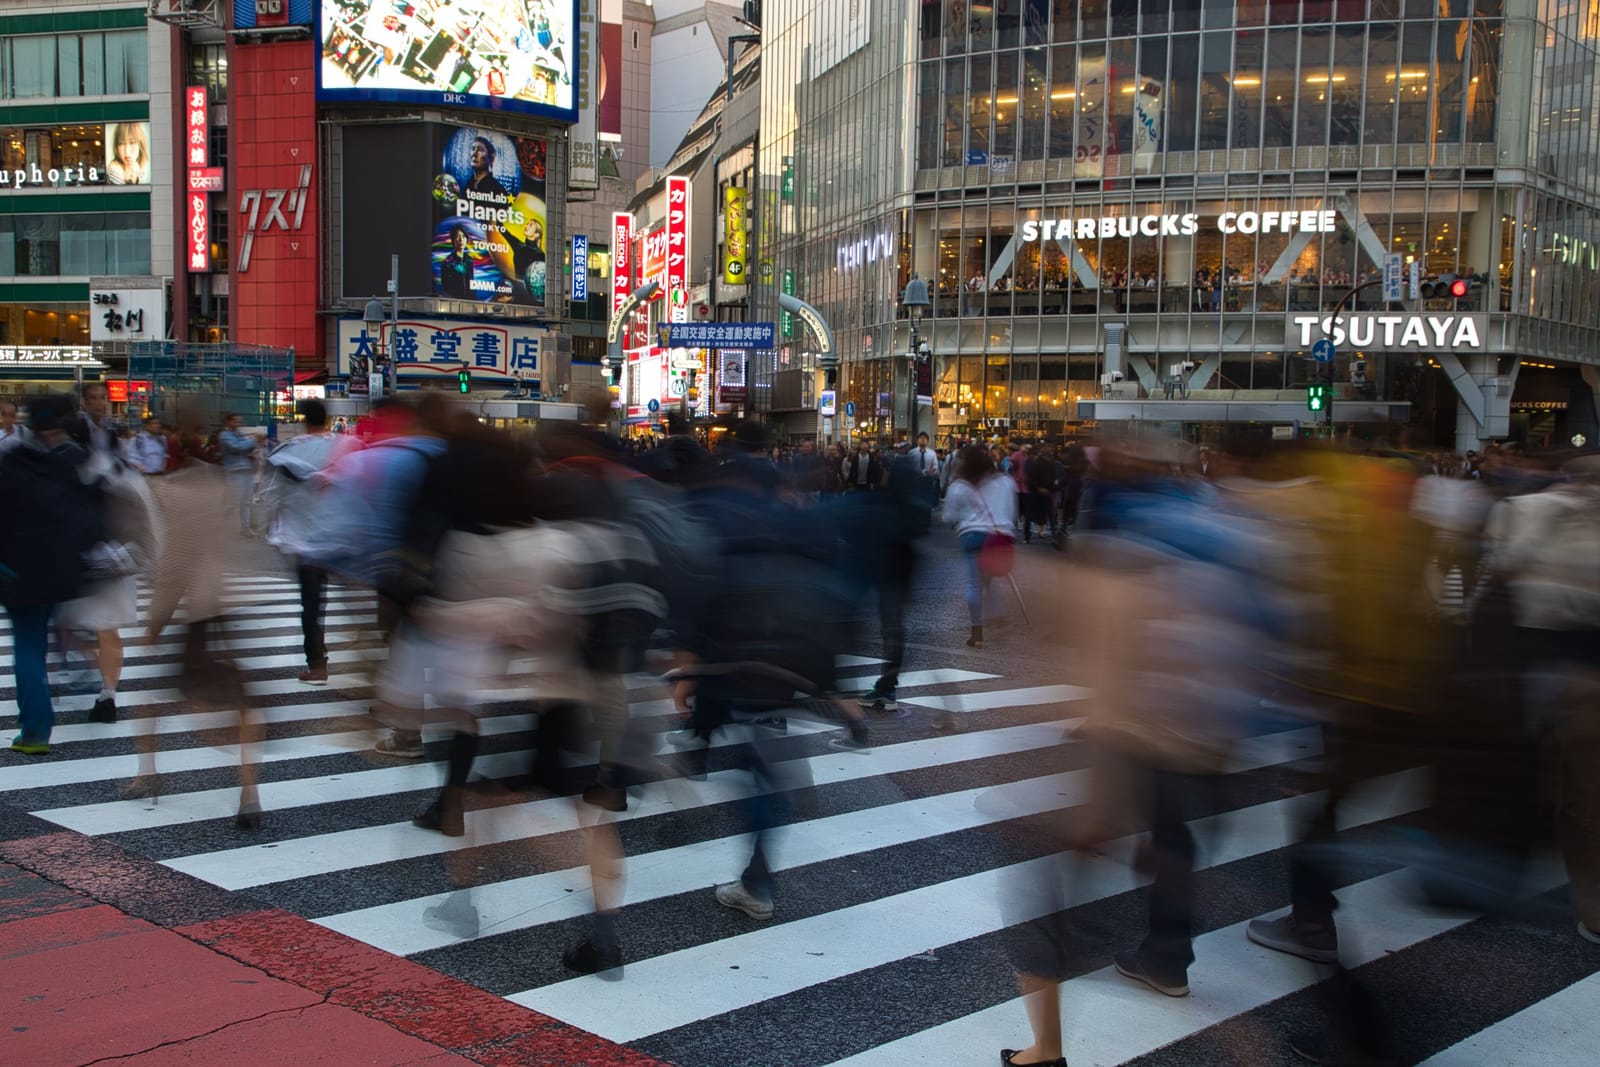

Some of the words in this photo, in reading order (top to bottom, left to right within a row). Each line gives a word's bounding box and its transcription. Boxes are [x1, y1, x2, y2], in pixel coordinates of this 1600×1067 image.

[442, 92, 466, 104] DHC
[465, 188, 507, 204] teamLab
[236, 165, 312, 272] クスリ
[456, 198, 525, 225] Planets
[476, 223, 506, 233] TOKYO
[669, 189, 685, 267] カラオケ
[1022, 213, 1199, 242] STARBUCKS
[1217, 210, 1336, 234] COFFEE
[473, 240, 510, 253] TOYOSU
[575, 236, 585, 299] 大盛堂商事ビル
[728, 263, 742, 273] 4F
[469, 280, 513, 294] DMM.com
[103, 308, 143, 332] 松川
[1294, 316, 1480, 348] TSUTAYA
[671, 326, 771, 340] 全国交通安全運動実施中
[349, 328, 539, 371] 大盛堂書店
